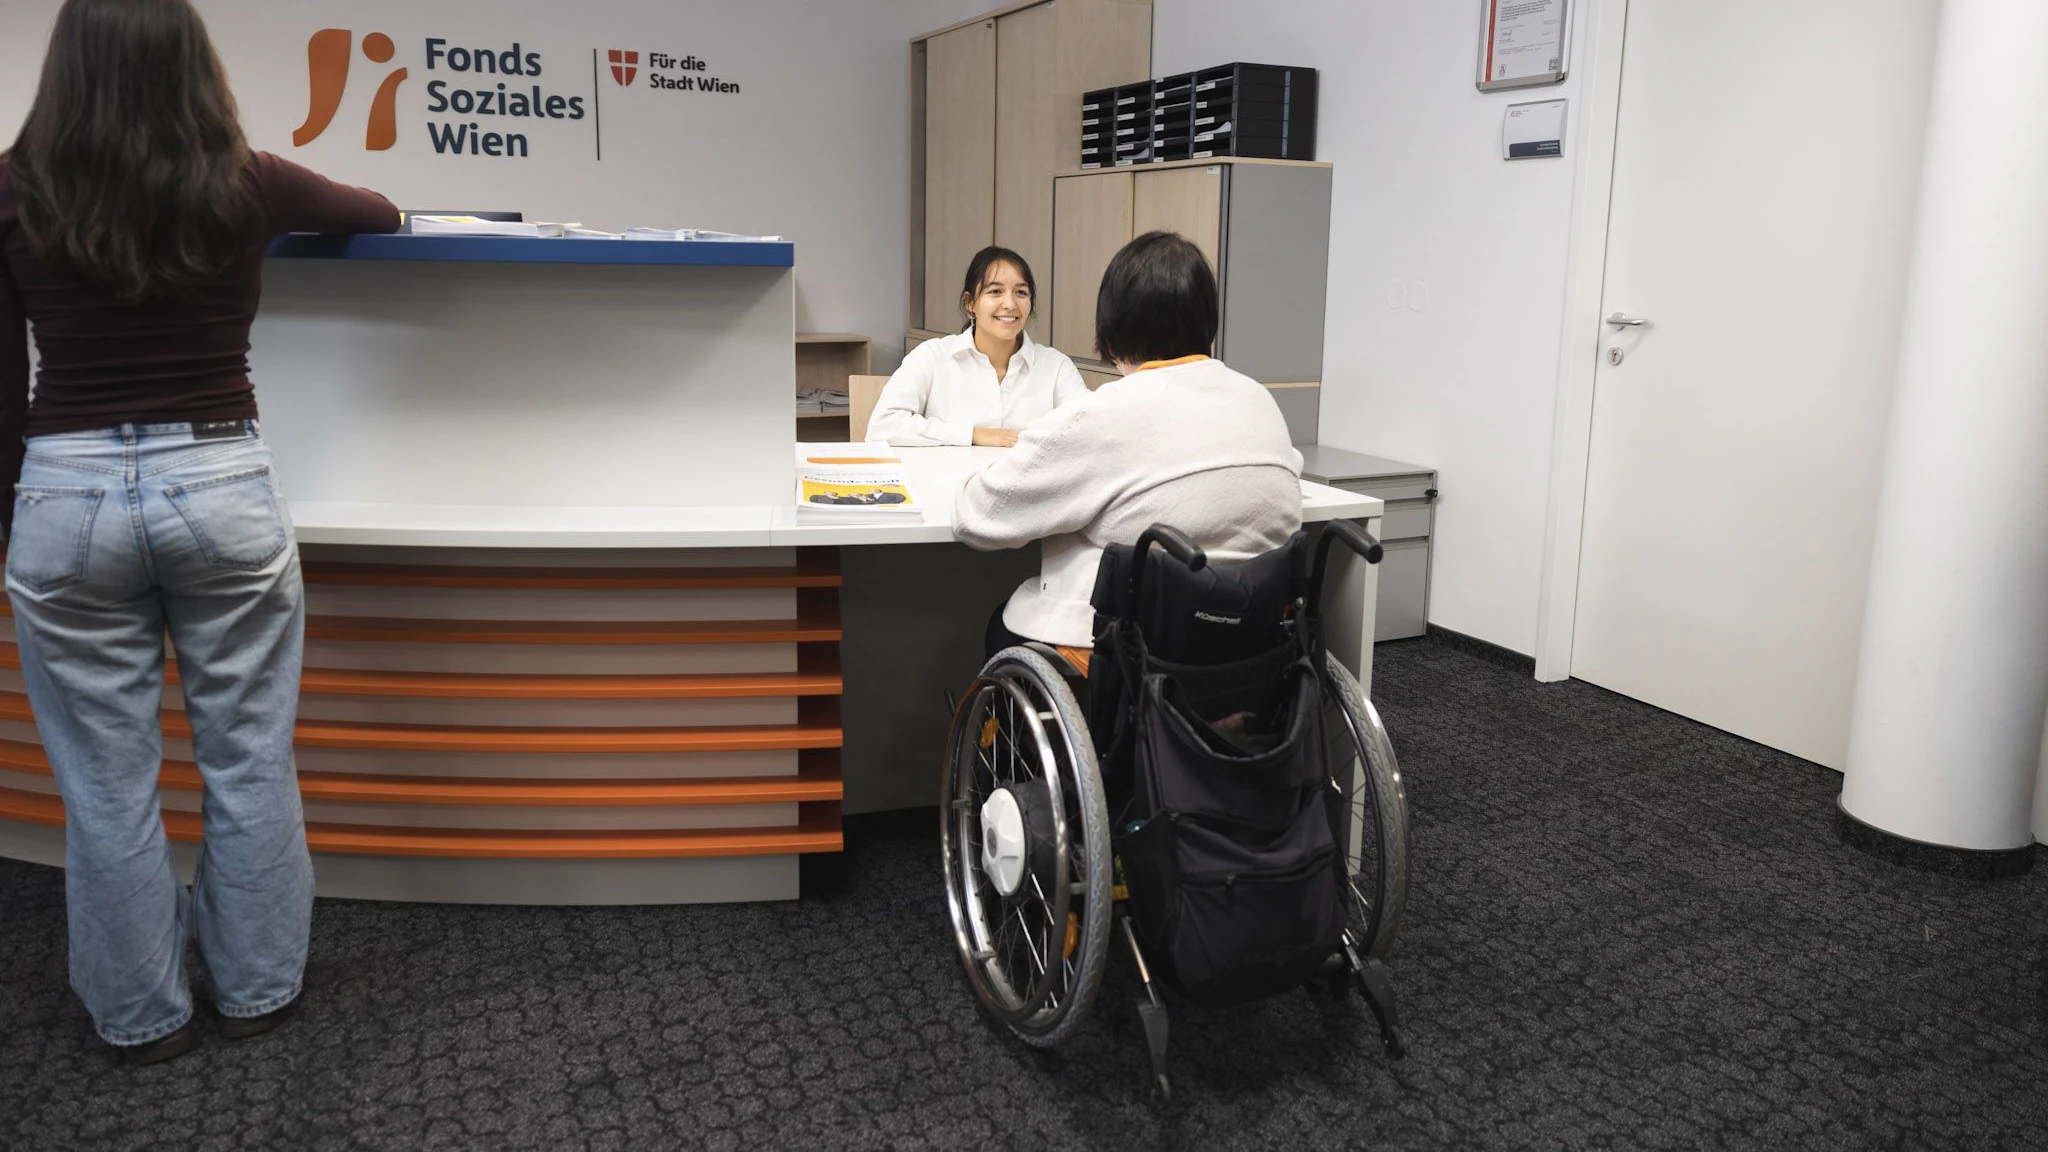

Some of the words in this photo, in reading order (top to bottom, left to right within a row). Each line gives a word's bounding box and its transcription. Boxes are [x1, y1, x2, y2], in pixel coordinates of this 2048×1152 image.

[426, 38, 541, 76] Fonds
[649, 52, 677, 69] Für
[680, 56, 706, 71] die
[427, 80, 584, 119] Soziales
[650, 73, 694, 91] Stadt
[697, 77, 740, 93] Wien
[427, 122, 528, 157] Wien
